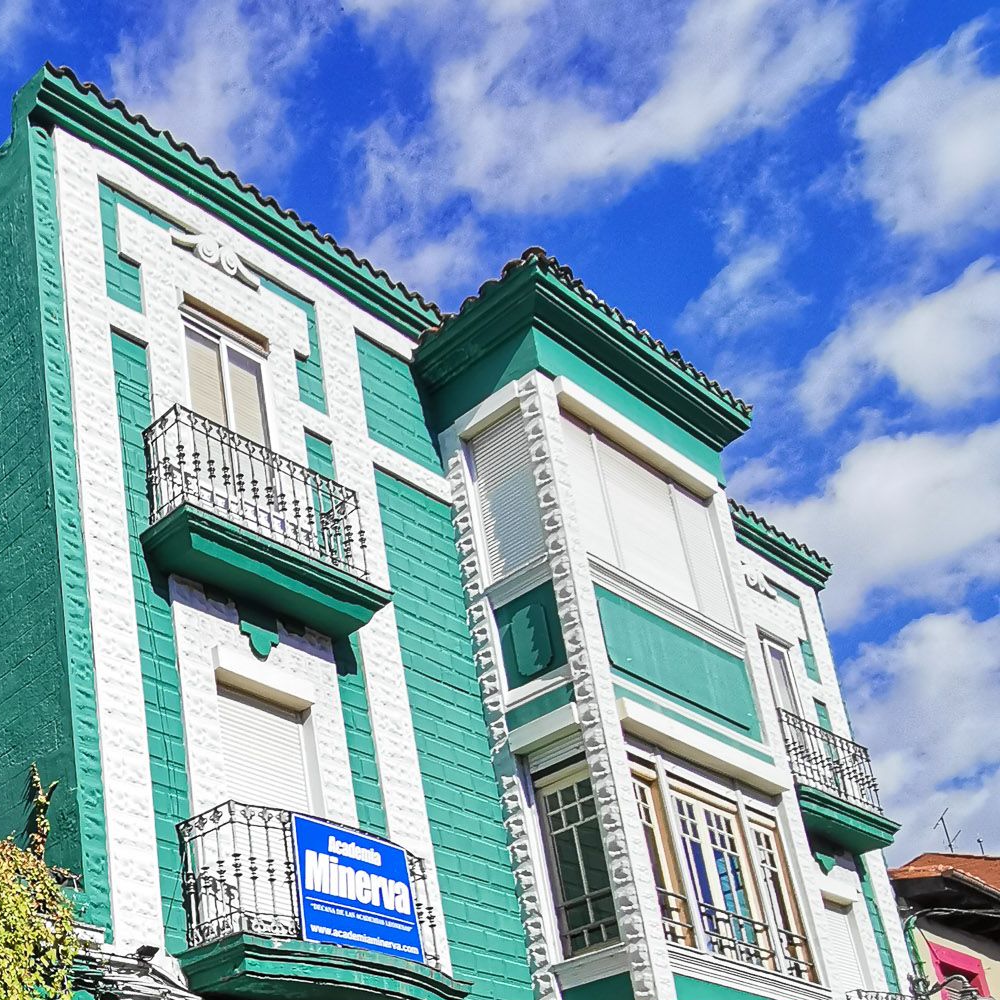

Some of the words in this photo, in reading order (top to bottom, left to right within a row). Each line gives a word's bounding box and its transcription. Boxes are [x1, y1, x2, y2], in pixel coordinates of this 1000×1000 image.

[328, 836, 382, 867] Academia
[305, 849, 411, 916] Minerva
[335, 909, 345, 917] DE
[345, 911, 356, 919] LAS
[310, 924, 419, 955] www.academiaminerva.com
